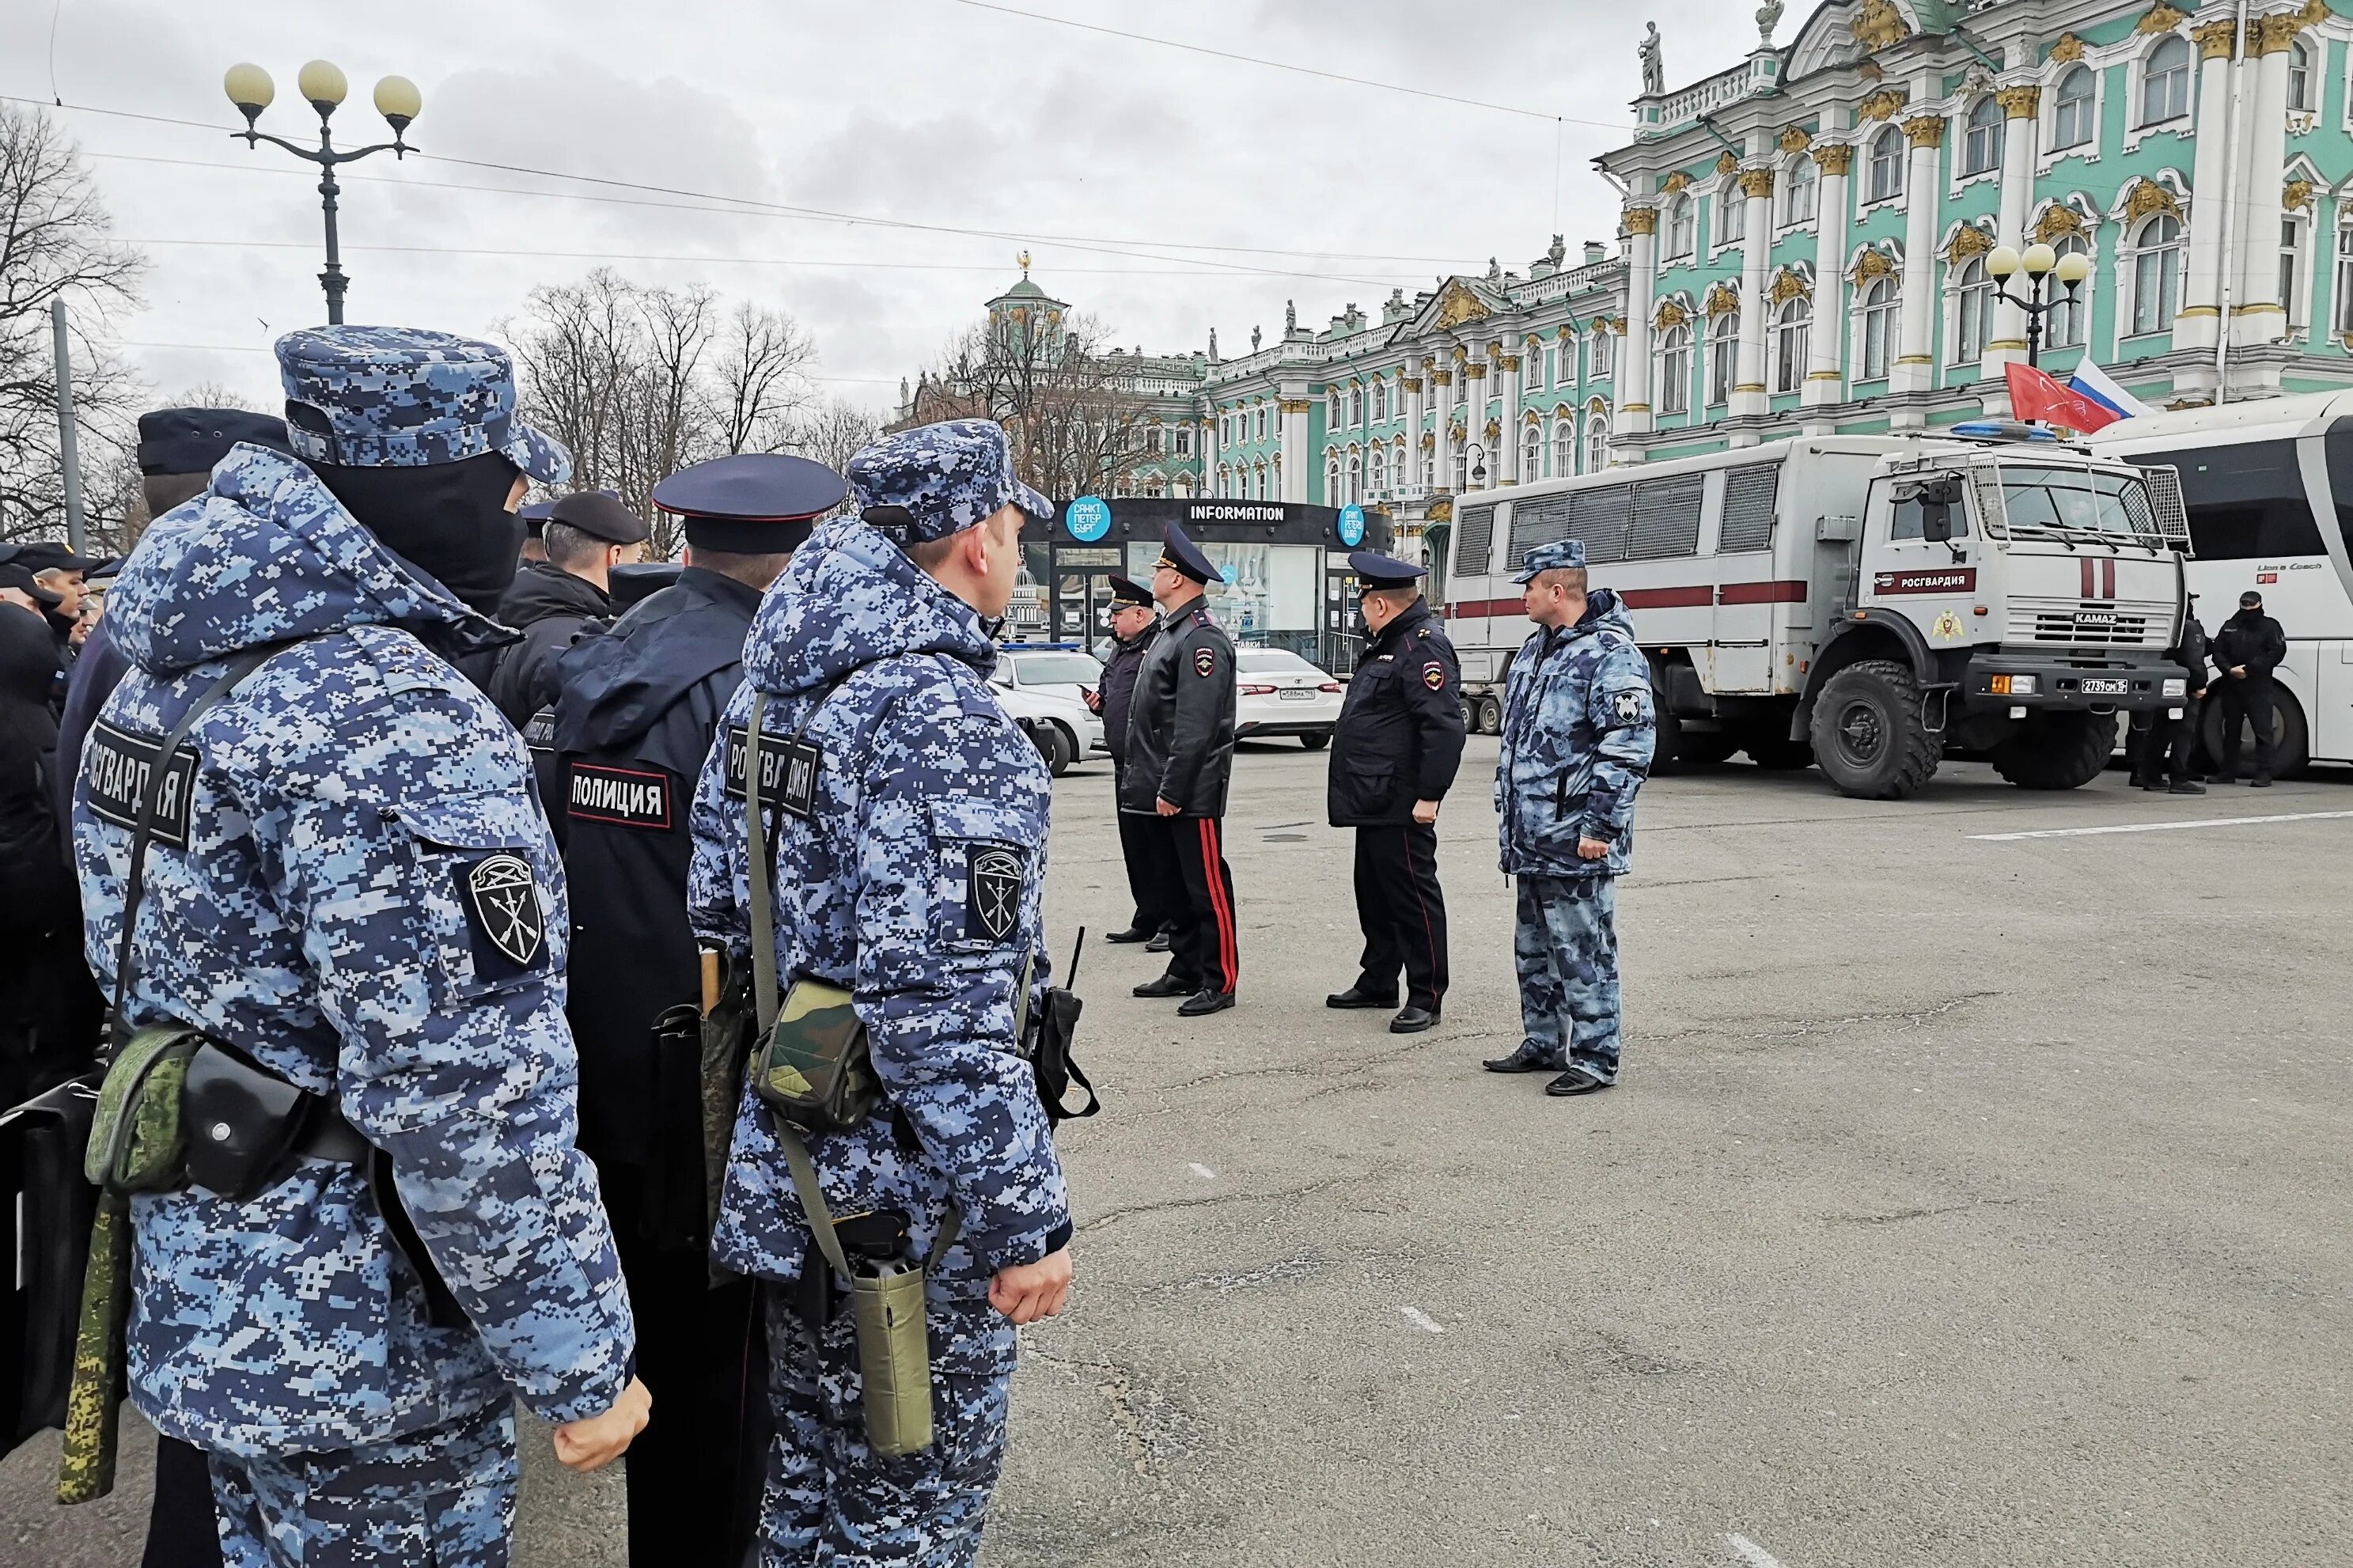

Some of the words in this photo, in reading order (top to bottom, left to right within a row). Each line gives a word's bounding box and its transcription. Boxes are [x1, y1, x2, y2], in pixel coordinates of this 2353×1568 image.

[1074, 503, 1101, 513] САНКТ
[1191, 506, 1284, 521] INFORMATION
[1074, 513, 1102, 524] ПЕТЕР
[1074, 523, 1097, 533] БУРГ
[1901, 575, 1965, 588] РОСГВАРДИЯ
[2075, 613, 2117, 624] KAMAZ
[572, 775, 662, 817] ПОЛИЦИЯ
